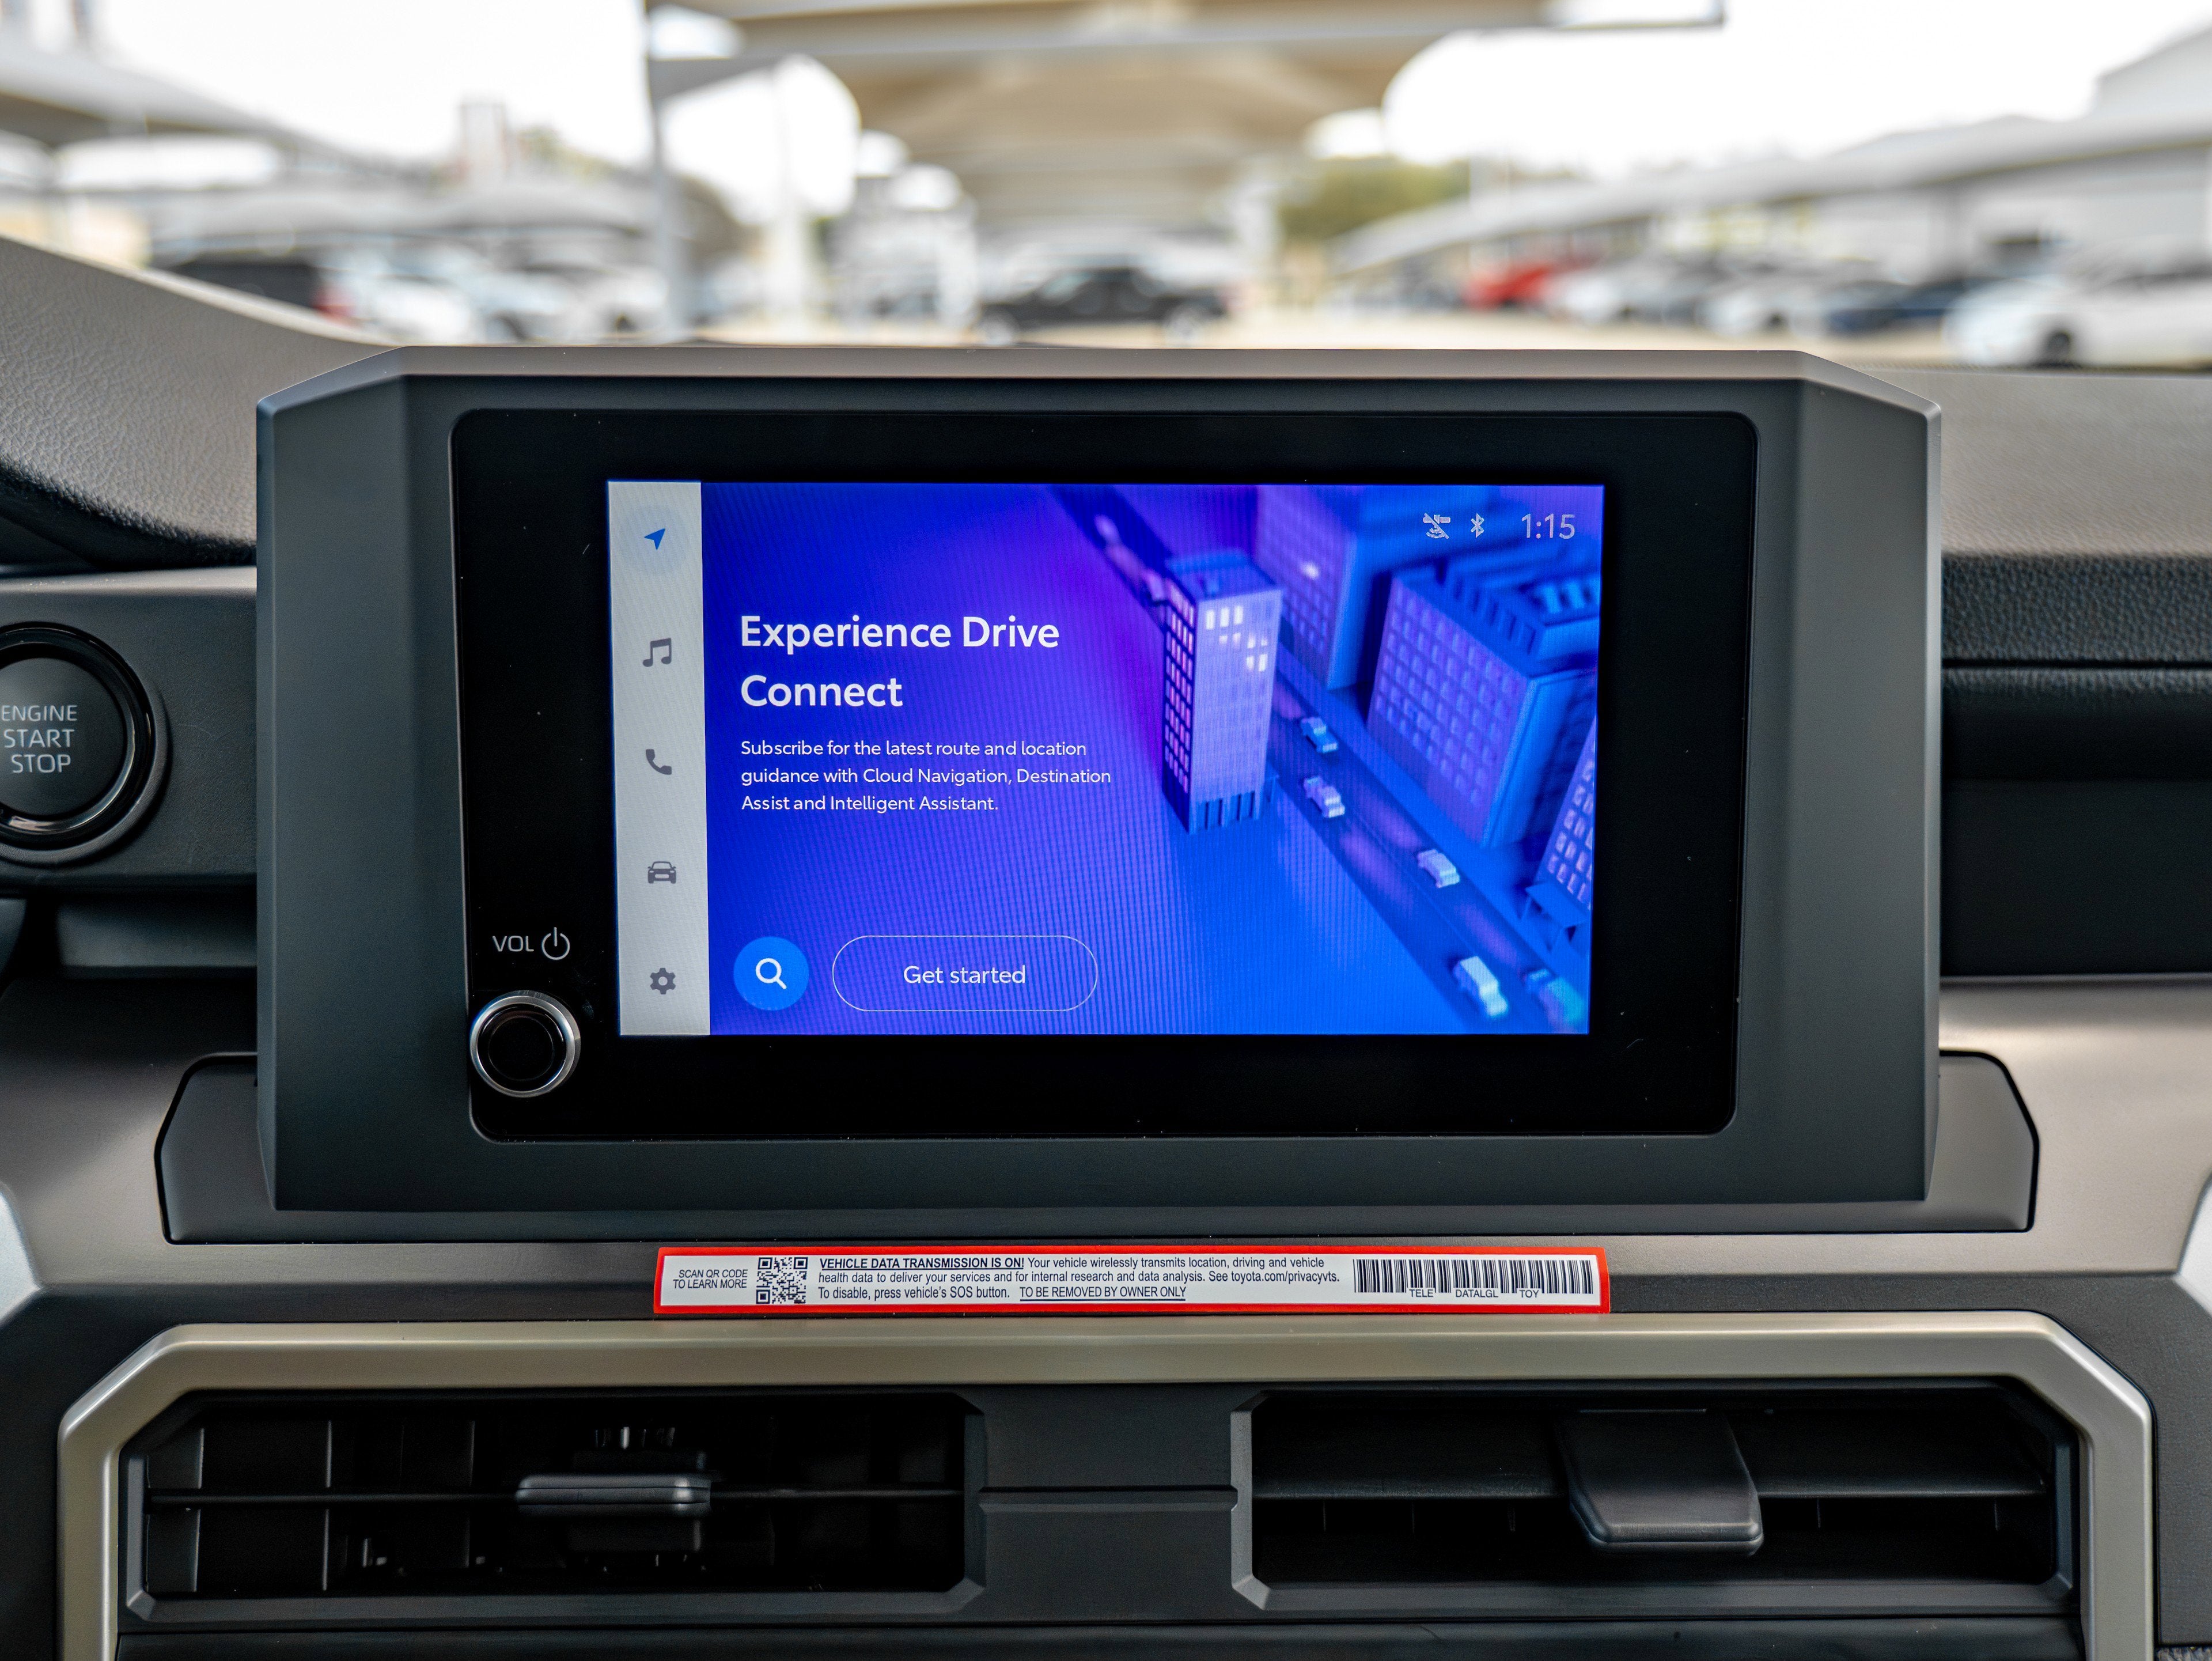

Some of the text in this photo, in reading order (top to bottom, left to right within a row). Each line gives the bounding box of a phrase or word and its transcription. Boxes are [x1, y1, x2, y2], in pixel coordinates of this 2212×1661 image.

[1521, 513, 1575, 539] 1:15
[741, 615, 1060, 654] Experience Drive
[740, 675, 903, 707] Connect
[1, 705, 78, 722] ENGINE
[3, 729, 75, 748] START
[741, 740, 1086, 755] Subscribe for the latest route and location
[11, 754, 71, 774] STOP
[741, 768, 1111, 786] guidance with Cloud Navigation, Destination
[741, 796, 998, 814] Assist and Intelligent Assistant.
[492, 935, 534, 952] VOL
[903, 964, 1026, 984] Get started
[820, 1257, 1324, 1270] VEHICLE DATA TRANSMISSION IS ON! Your vehicle wirelessly transmits location, driving and vehicle
[679, 1269, 748, 1278] SCAN QR CODE
[819, 1270, 1340, 1285] health data to deliver your services and for internal research and data analysis. See toyota.com/privacyvts.
[673, 1279, 747, 1289] TO LEARN MORE
[818, 1287, 830, 1299] To
[833, 1287, 870, 1300] disable,
[874, 1289, 901, 1301] press
[950, 1286, 972, 1297] SOS
[976, 1286, 1009, 1297] button.
[1020, 1287, 1033, 1297] TO
[1036, 1287, 1049, 1297] BE
[1052, 1287, 1101, 1297] REMOVED
[1104, 1287, 1118, 1297] BY
[1120, 1286, 1158, 1297] OWNER
[1160, 1286, 1186, 1297] ONLY
[1409, 1289, 1539, 1298] TELE DATALGL TOY
